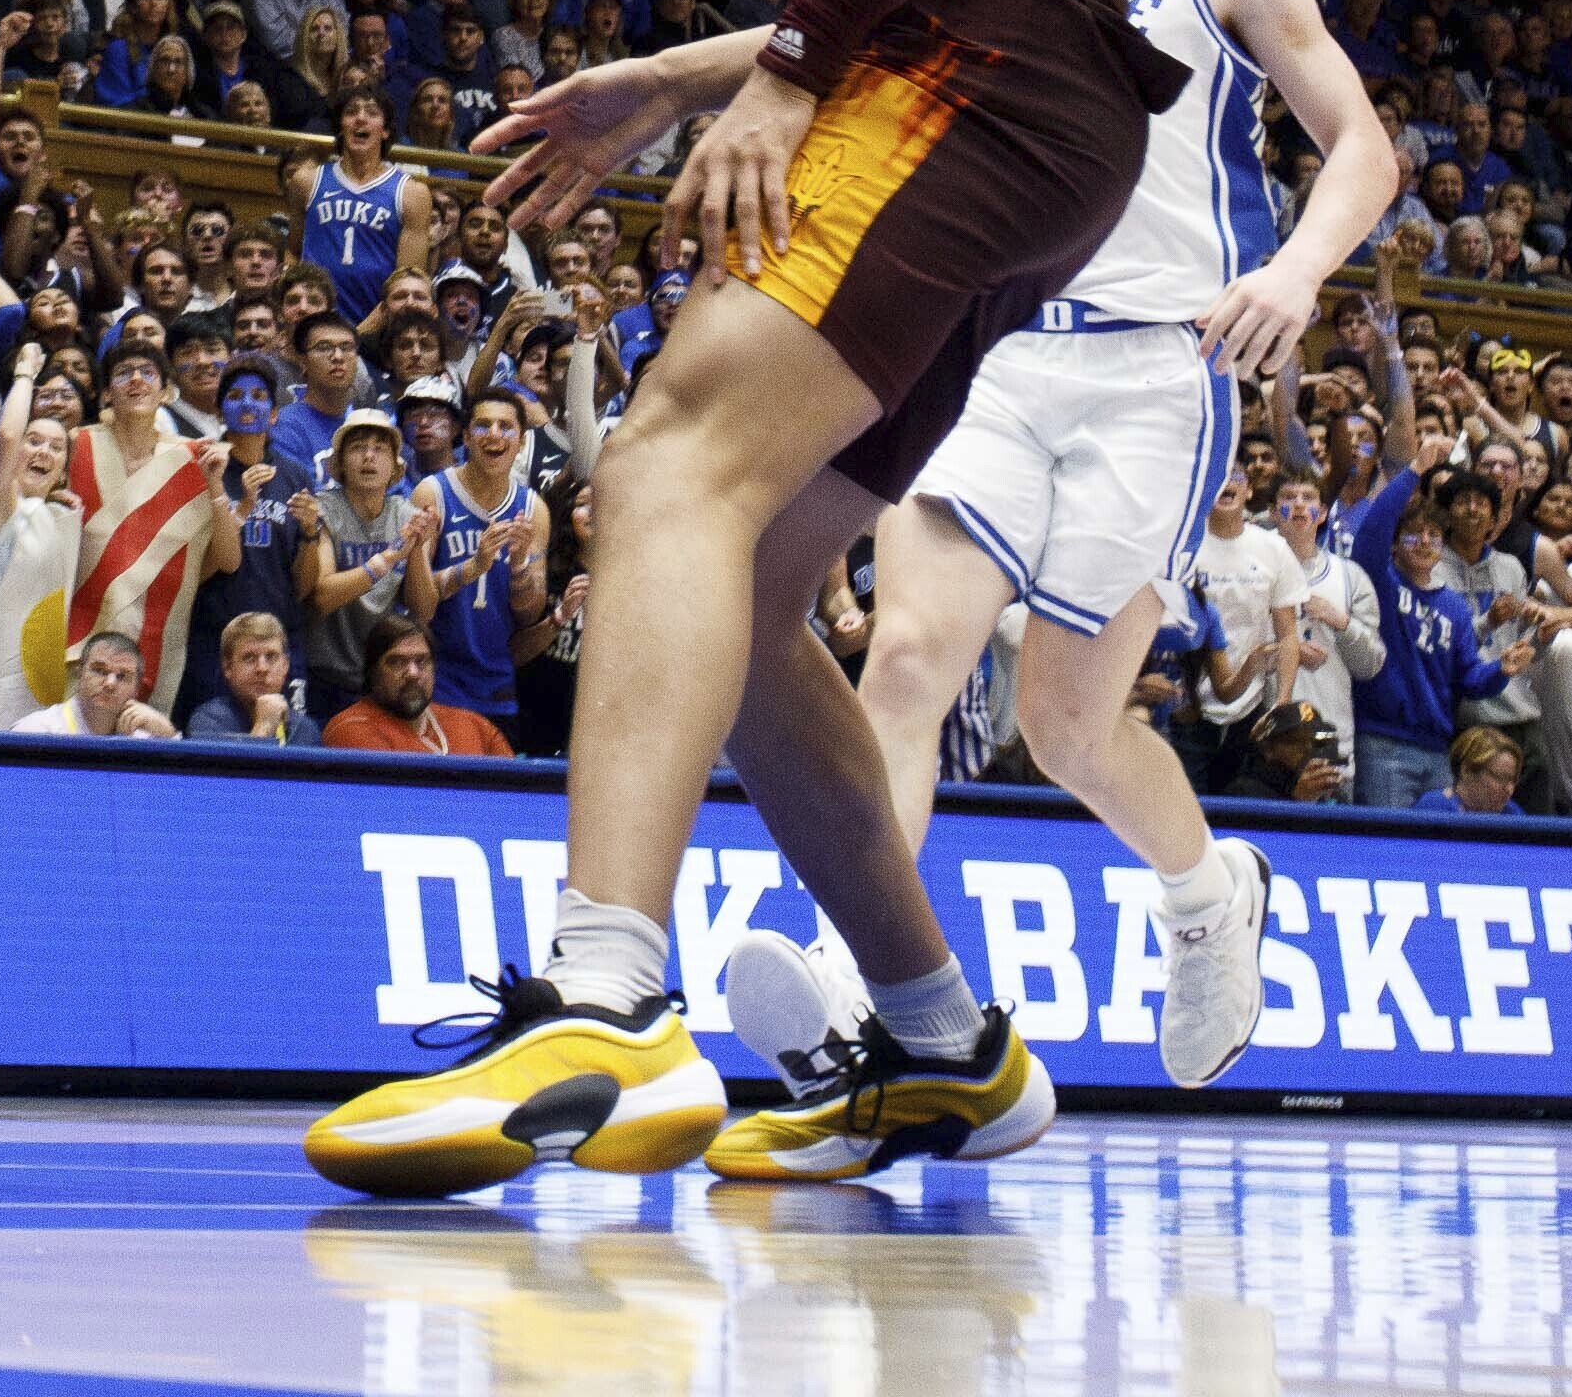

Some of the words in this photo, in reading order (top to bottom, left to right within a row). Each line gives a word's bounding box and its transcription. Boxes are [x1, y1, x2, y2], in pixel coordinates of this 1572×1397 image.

[317, 199, 392, 231] DUKE
[341, 225, 355, 265] 1
[472, 572, 488, 609] 1
